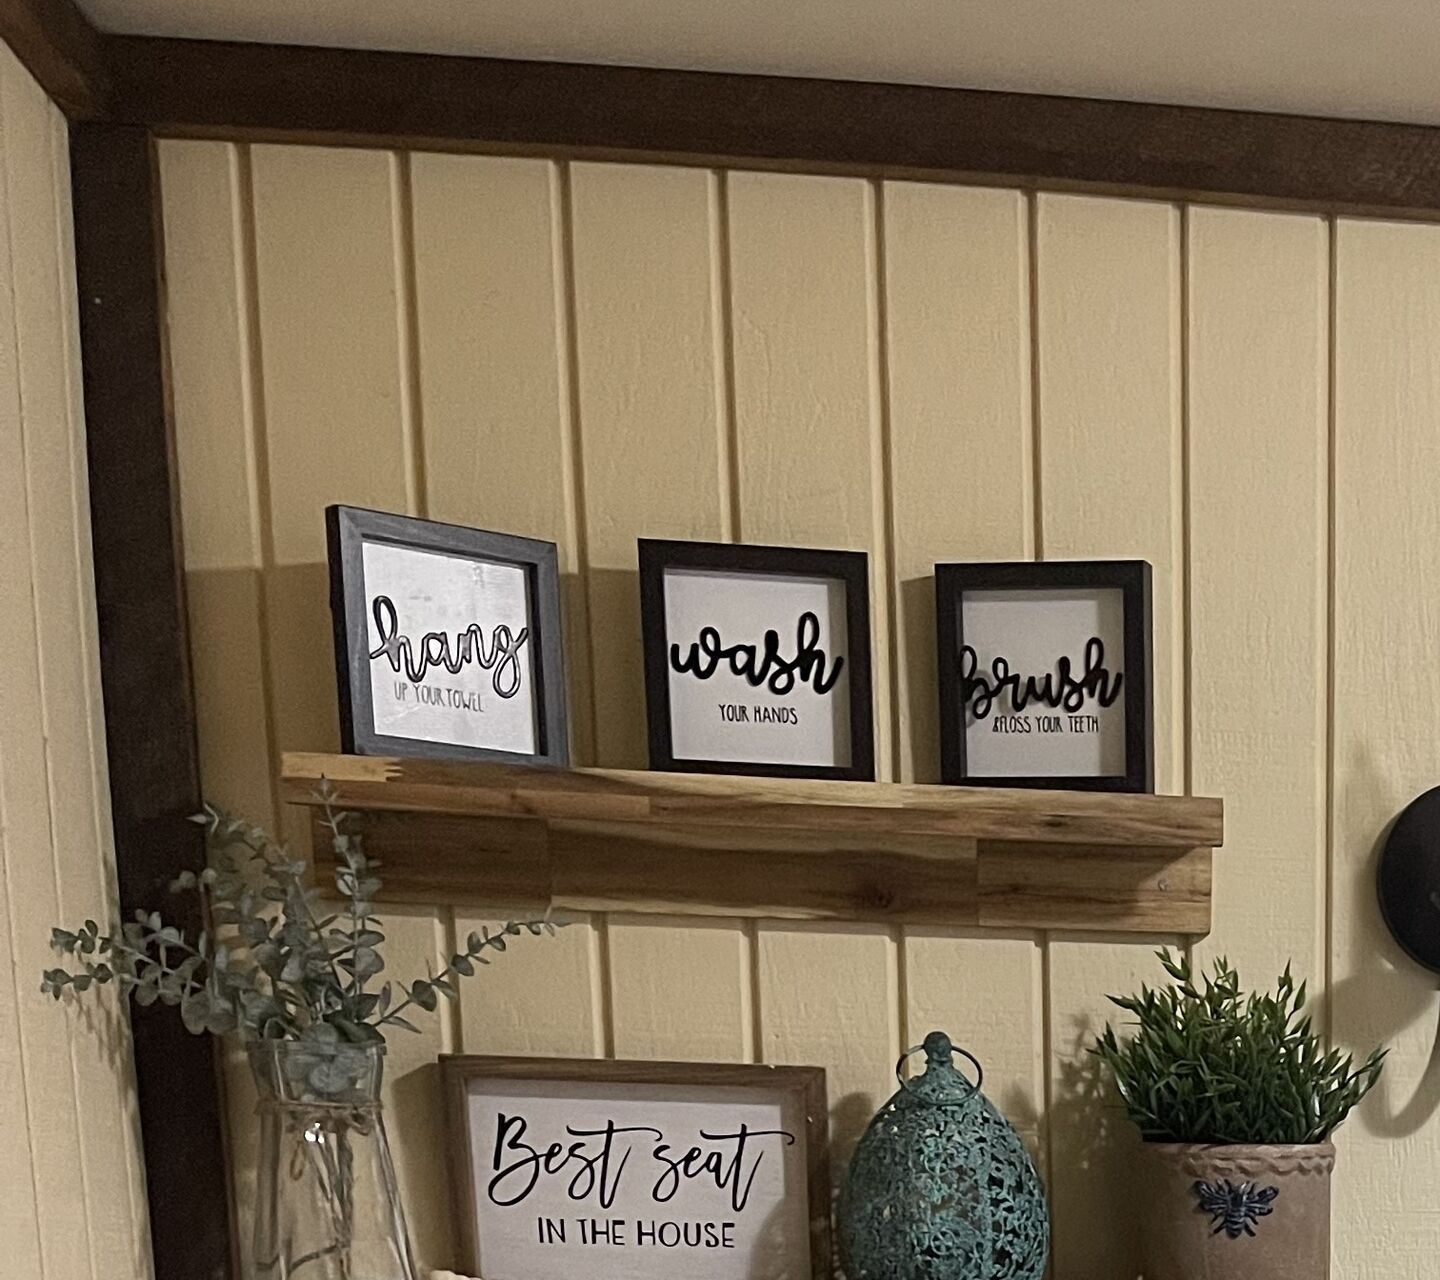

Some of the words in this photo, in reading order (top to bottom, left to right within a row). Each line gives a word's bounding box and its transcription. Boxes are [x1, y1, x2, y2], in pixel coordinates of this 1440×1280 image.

[369, 595, 529, 699] hang
[670, 611, 844, 695] wash
[393, 681, 408, 701] UP
[413, 684, 445, 707] YOUR
[447, 689, 484, 713] TOWEL
[960, 636, 1123, 719] brush
[718, 704, 749, 722] YOUR
[753, 705, 798, 725] HANDS
[1035, 716, 1063, 734] YOUR
[1067, 715, 1099, 734] TEETH
[488, 1112, 662, 1209] Best
[652, 1123, 795, 1212] seat
[537, 1216, 566, 1245] IN
[577, 1218, 625, 1246] THE
[637, 1220, 736, 1248] HOUSE
